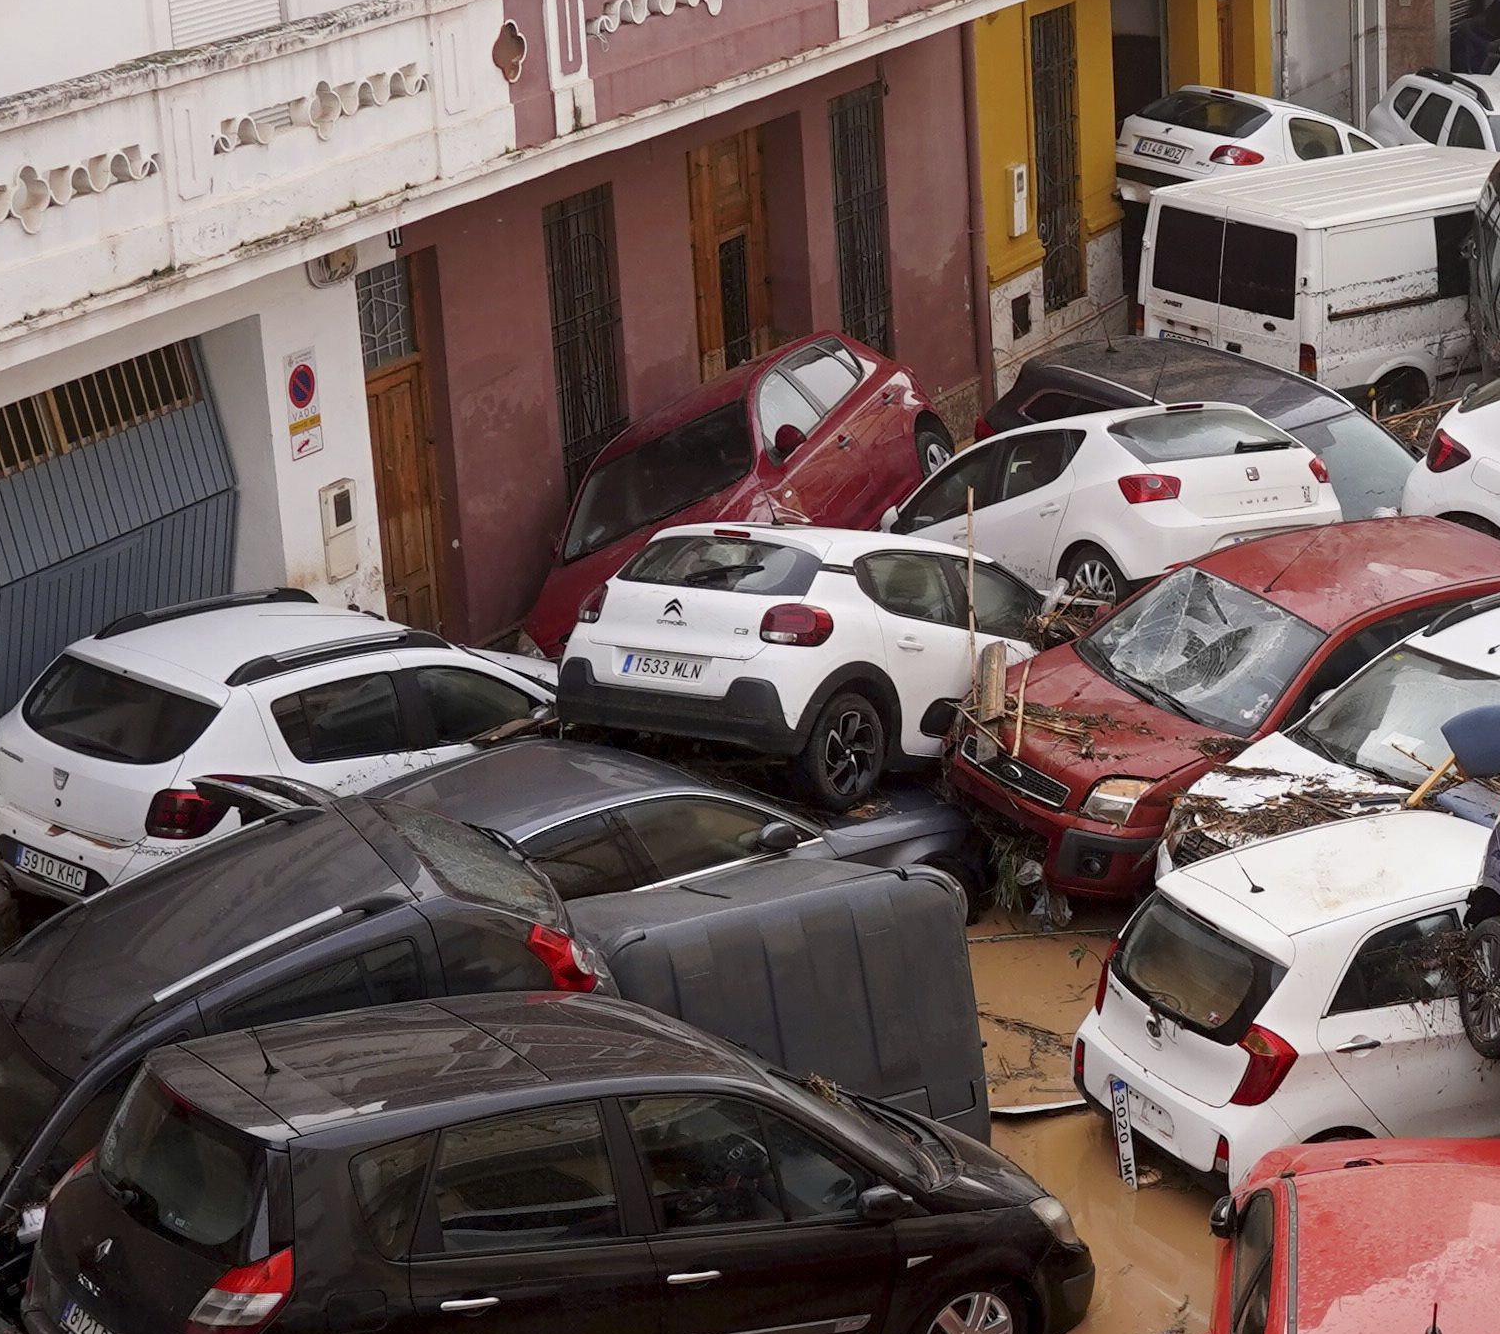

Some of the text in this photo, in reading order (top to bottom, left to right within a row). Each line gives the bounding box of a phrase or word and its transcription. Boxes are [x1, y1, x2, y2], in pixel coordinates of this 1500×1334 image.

[292, 405, 316, 421] VADO
[634, 656, 701, 680] 1533 MLN
[22, 850, 83, 887] 5910 KHC
[1114, 1094, 1130, 1145] 3020
